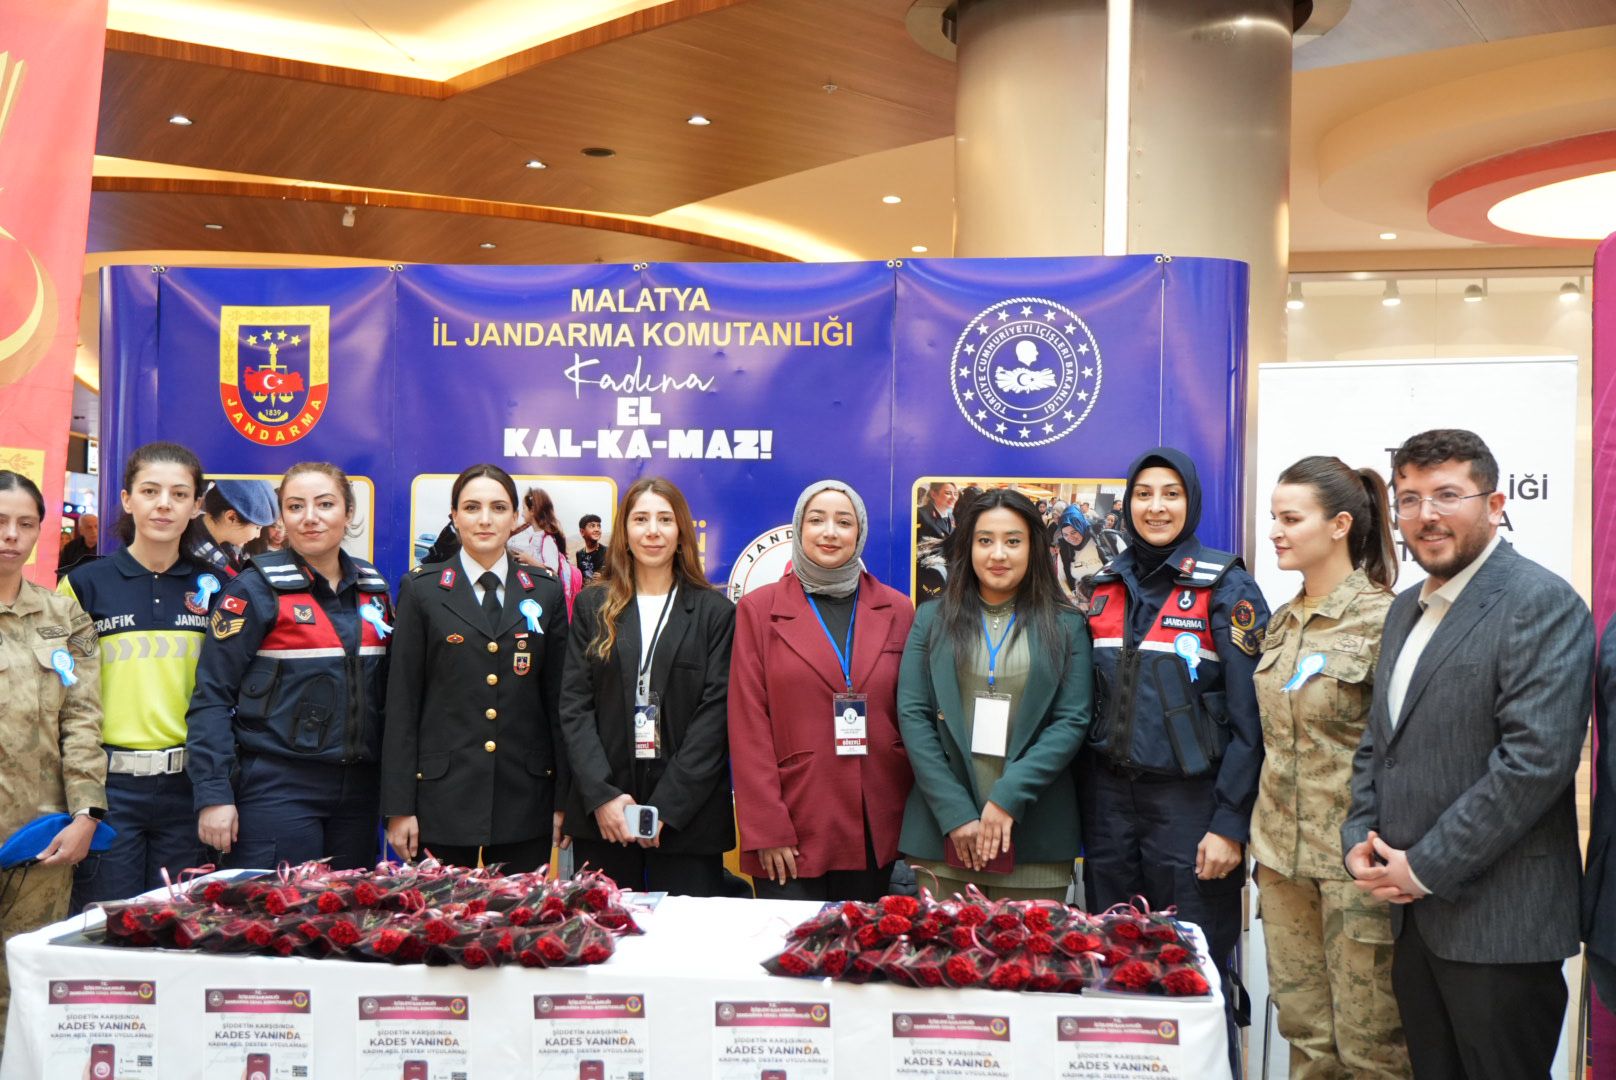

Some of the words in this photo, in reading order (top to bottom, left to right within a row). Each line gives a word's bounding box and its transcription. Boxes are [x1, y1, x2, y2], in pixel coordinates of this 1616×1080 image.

[571, 288, 710, 312] MALATYA
[432, 317, 457, 346] İL
[465, 322, 635, 347] JANDARMA
[643, 315, 853, 346] KOMUTANLIĞI
[1036, 324, 1073, 359] İÇİŞLERİ
[978, 324, 1033, 372] CUMHURİYETİ
[564, 353, 715, 399] Kadına
[1044, 362, 1074, 414] BAKANLIĞI
[978, 375, 1007, 415] TÜRKİYE
[228, 398, 322, 441] JANDARMA
[616, 396, 661, 426] EL
[504, 428, 773, 460] KAL-KA-MAZ!
[1163, 617, 1203, 628] JANDARMA
[58, 1022, 95, 1030] KADES
[99, 1022, 146, 1030] YANINDA
[215, 1031, 250, 1039] KADES
[254, 1031, 301, 1040] YANINDA
[370, 1038, 407, 1046] KADES
[410, 1038, 459, 1046] YANINDA
[545, 1038, 582, 1046] KADES
[586, 1037, 636, 1045] YANINDA
[726, 1046, 764, 1054] KADES
[768, 1046, 820, 1054] YANINDA
[904, 1057, 943, 1066] KADES
[946, 1058, 1000, 1068] YANINDA
[1069, 1061, 1110, 1070] KADES
[1113, 1062, 1169, 1073] YANINDA
